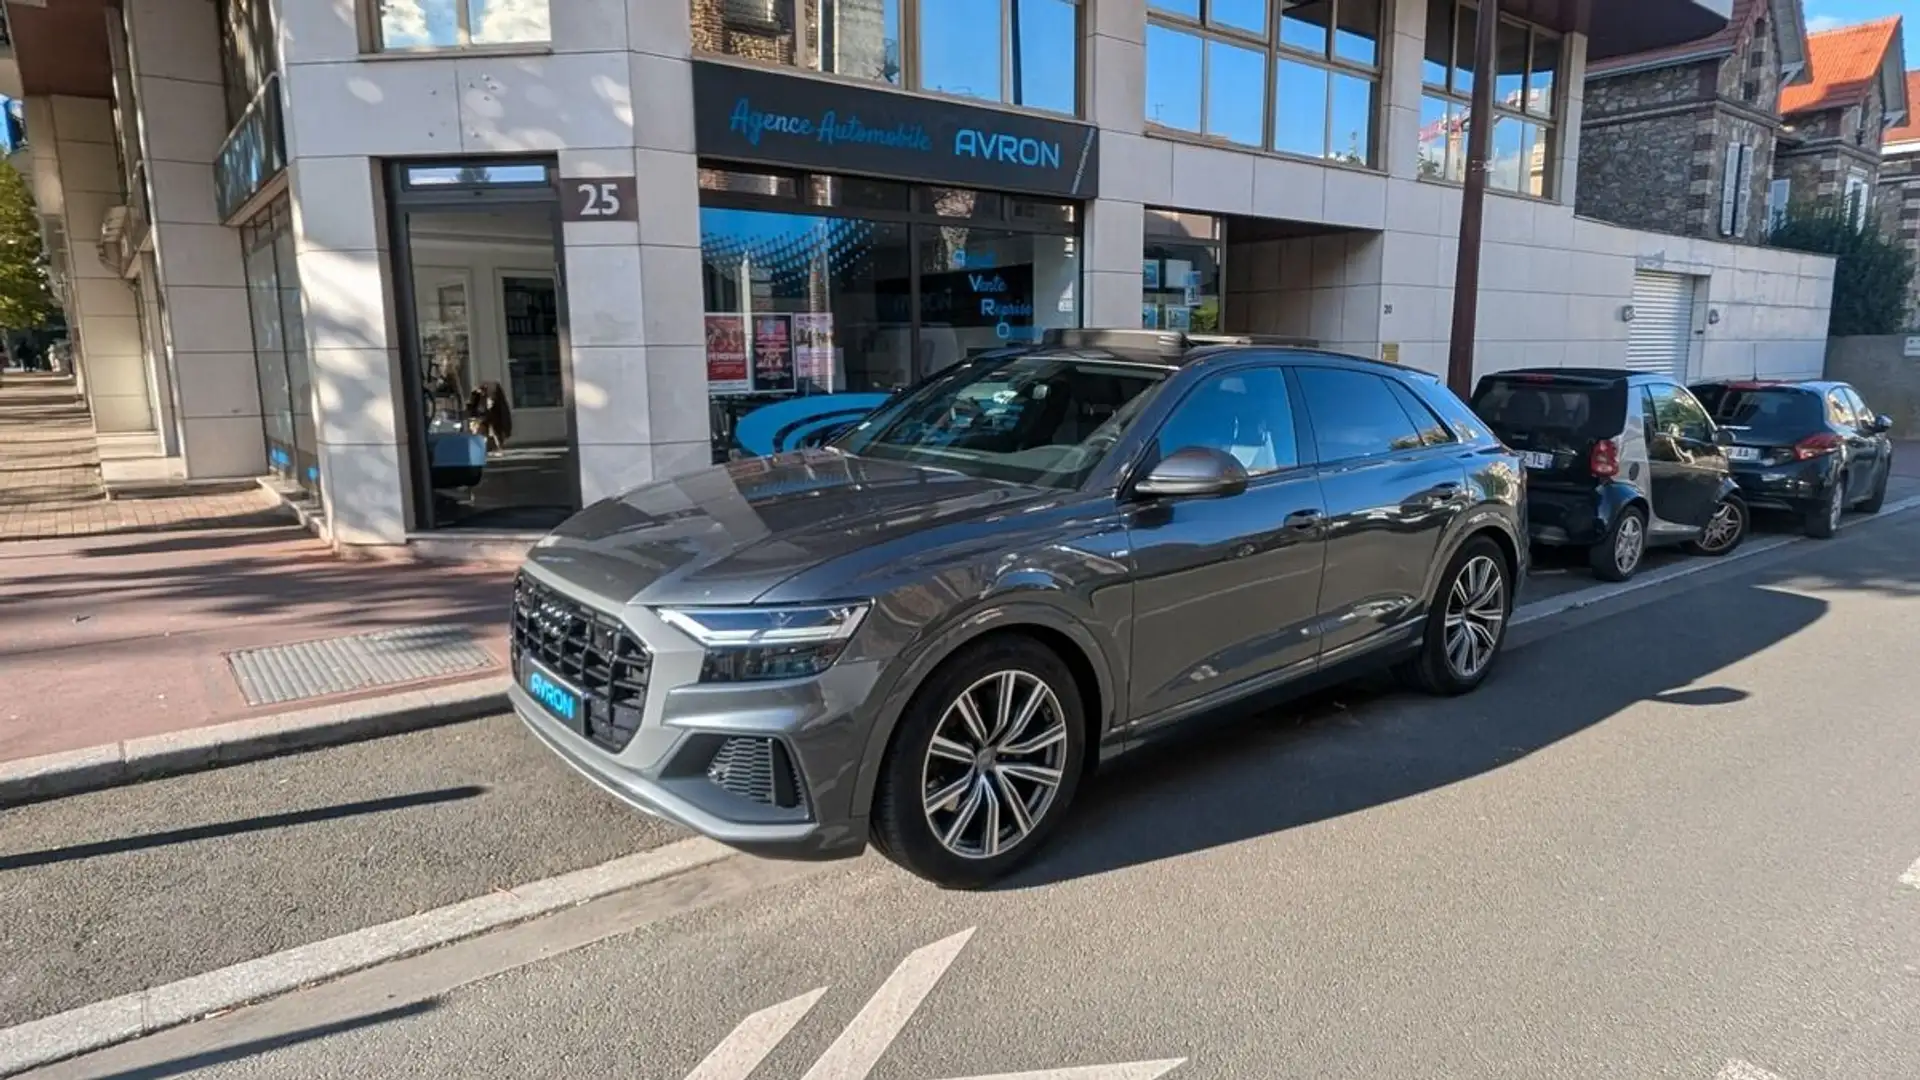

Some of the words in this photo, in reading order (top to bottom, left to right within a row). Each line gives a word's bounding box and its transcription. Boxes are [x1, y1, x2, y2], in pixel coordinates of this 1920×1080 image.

[730, 98, 812, 145] Agence
[816, 111, 932, 152] Automobile
[955, 129, 1060, 170] AVRON
[577, 183, 620, 216] 25
[530, 672, 575, 720] AVRON
